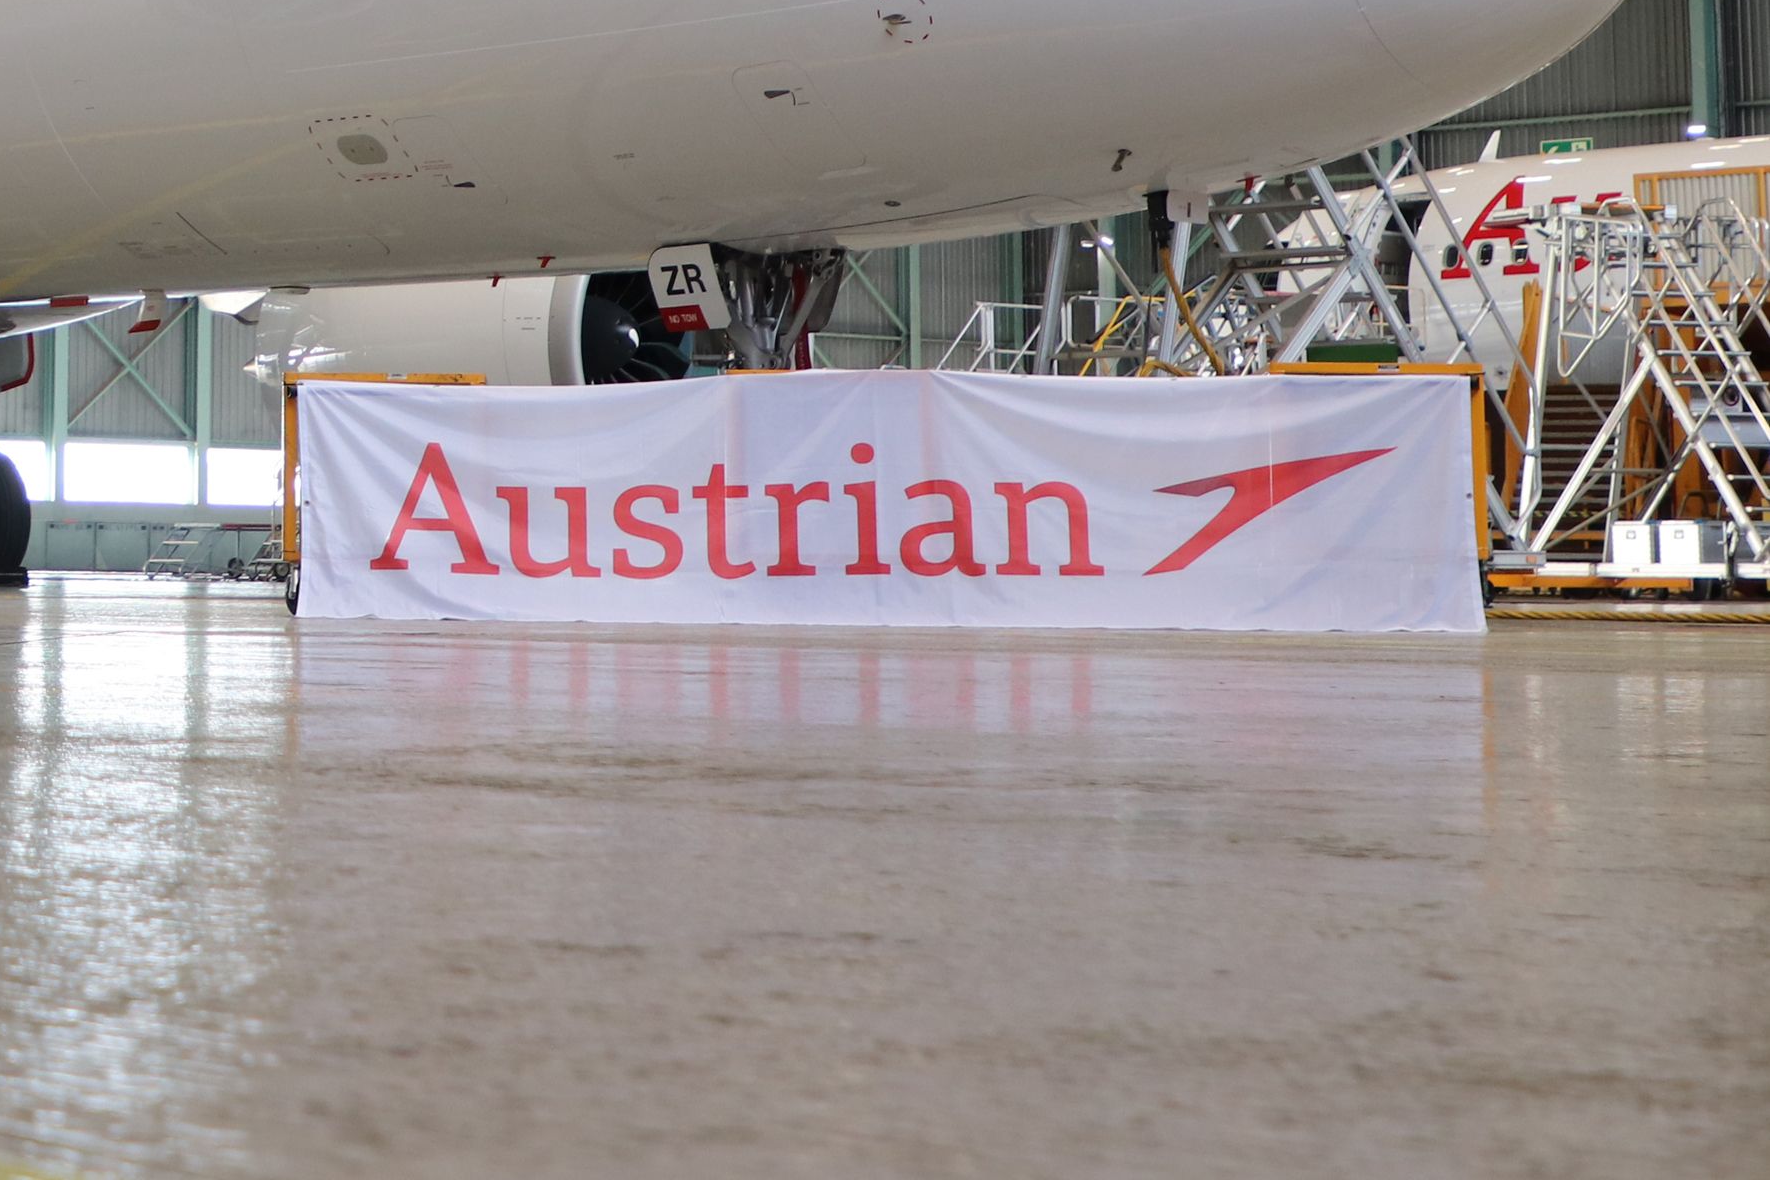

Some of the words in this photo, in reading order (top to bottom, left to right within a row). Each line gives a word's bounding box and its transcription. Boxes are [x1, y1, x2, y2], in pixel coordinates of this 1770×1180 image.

[660, 263, 707, 295] ZR
[669, 314, 680, 324] NO
[681, 314, 697, 322] TOW
[370, 442, 1105, 578] Austrian
